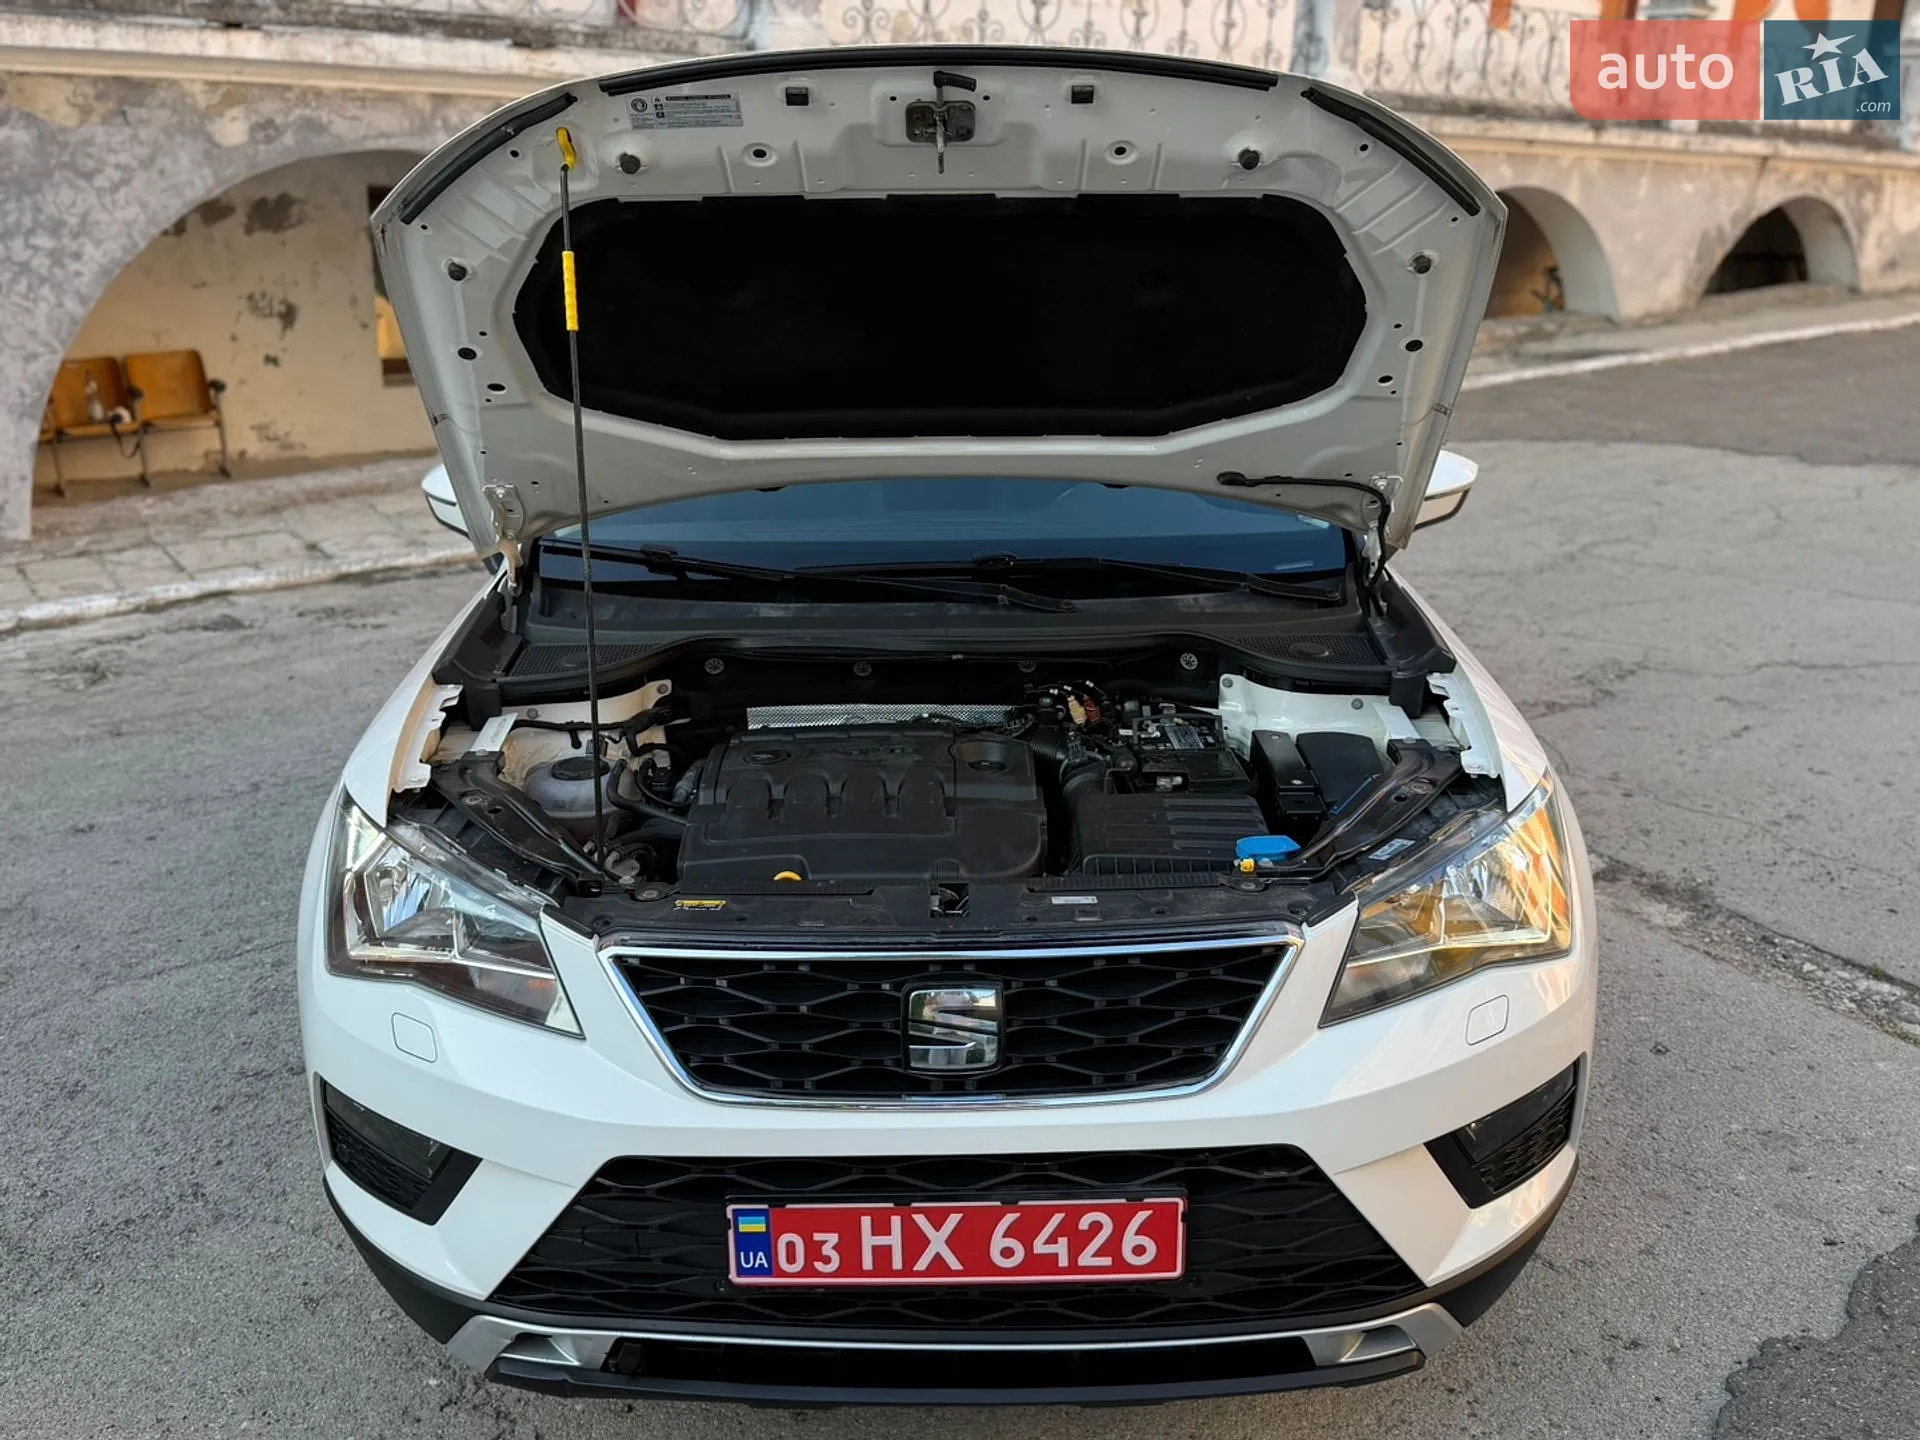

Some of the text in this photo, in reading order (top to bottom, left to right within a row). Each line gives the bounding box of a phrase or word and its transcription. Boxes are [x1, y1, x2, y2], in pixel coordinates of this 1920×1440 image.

[740, 1251, 769, 1269] UA
[777, 1209, 1158, 1274] 03 HX 6426
